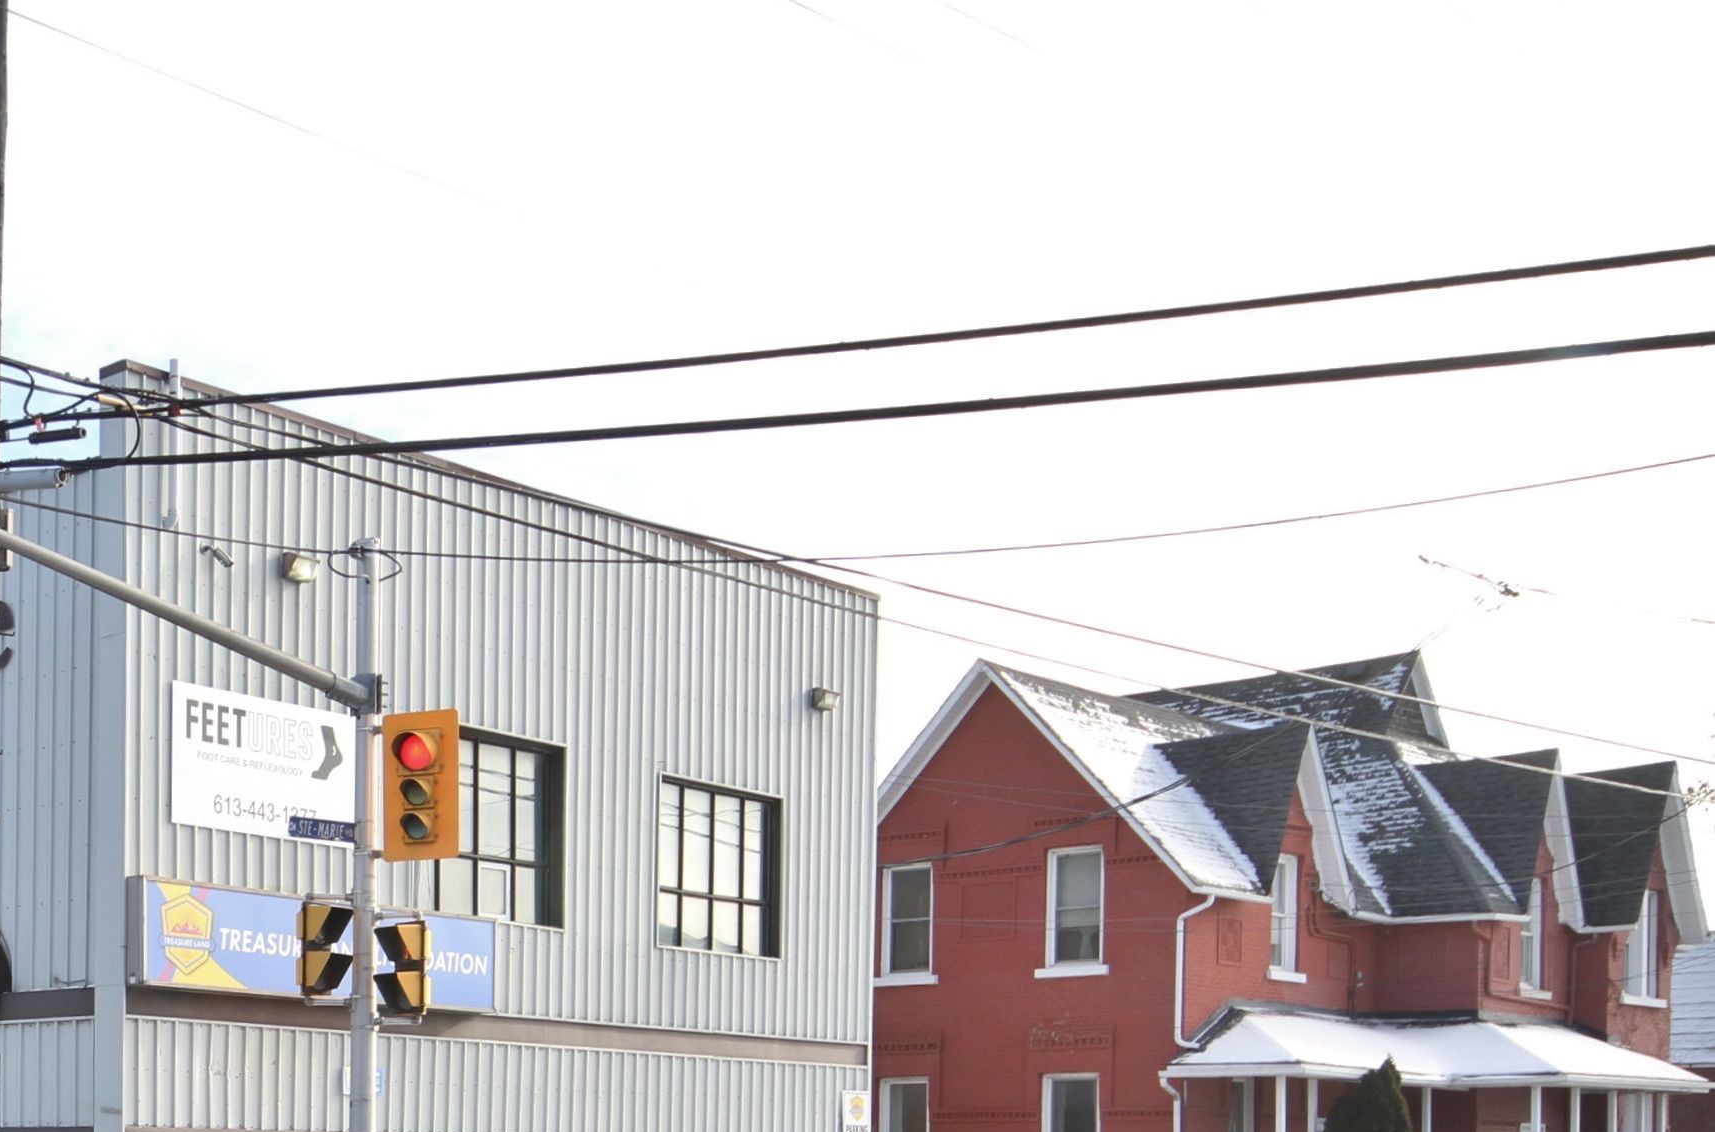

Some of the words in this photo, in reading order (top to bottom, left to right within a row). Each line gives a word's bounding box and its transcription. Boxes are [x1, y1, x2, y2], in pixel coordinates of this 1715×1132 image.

[185, 698, 313, 761] FEETURES
[196, 750, 218, 762] FOOT
[220, 755, 241, 767] CARE
[249, 760, 303, 777] REFLEXOLOGY
[299, 819, 345, 839] STE-MARIE
[164, 937, 192, 946] TREASURE
[193, 940, 211, 949] LAND
[219, 927, 303, 958] TREASUR
